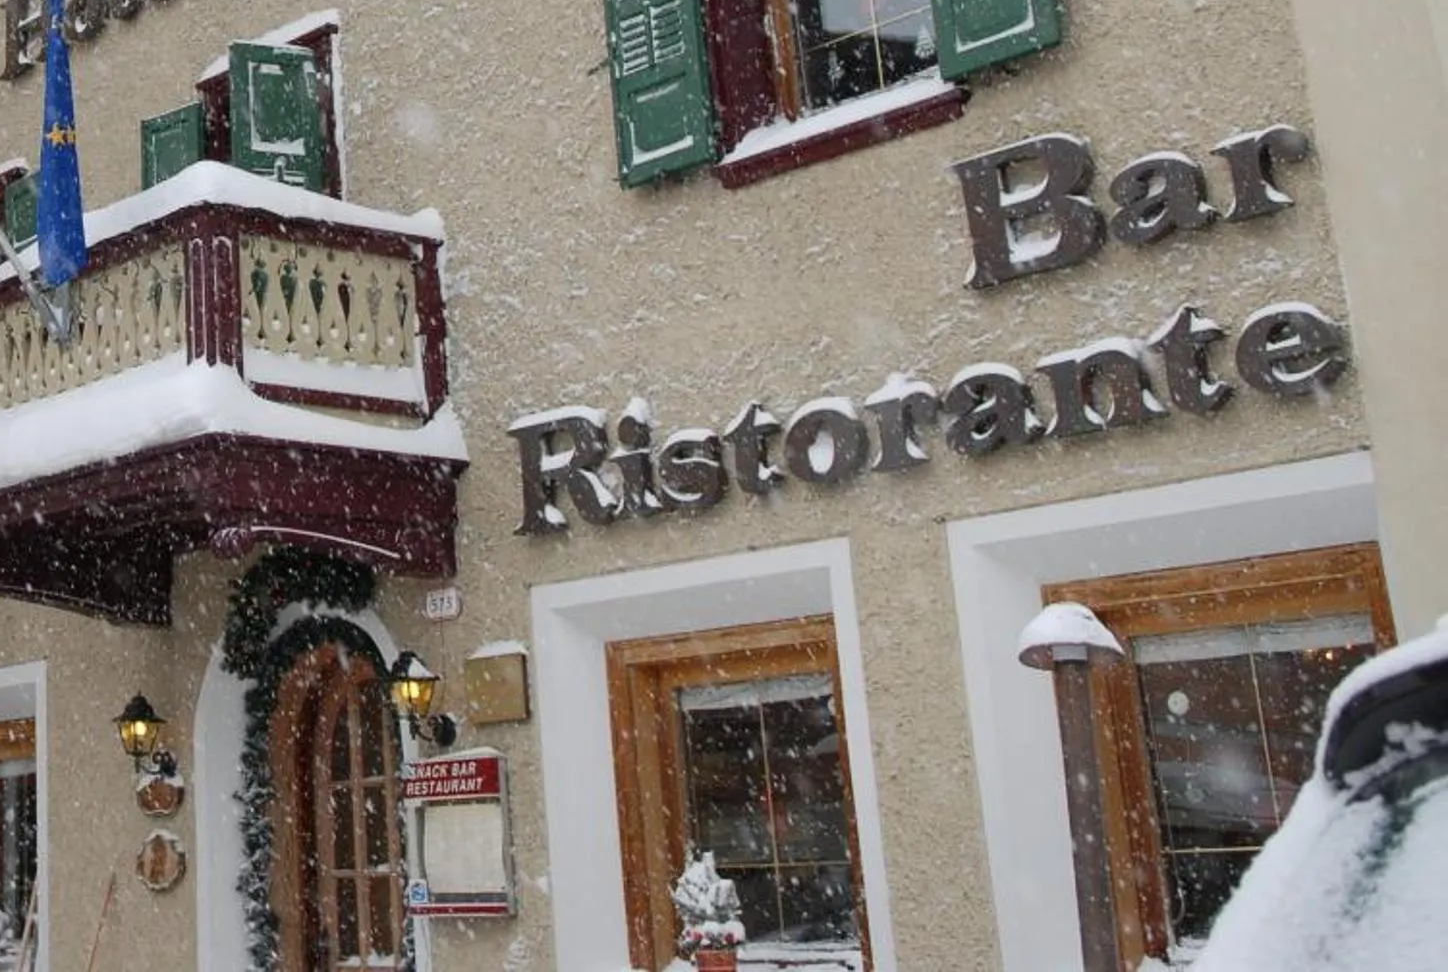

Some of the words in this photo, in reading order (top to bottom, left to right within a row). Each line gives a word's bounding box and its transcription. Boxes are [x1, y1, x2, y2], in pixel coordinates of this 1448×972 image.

[951, 124, 1310, 290] Bar
[509, 302, 1352, 536] Ristorante
[406, 777, 484, 796] RESTAURANT
[451, 760, 477, 777] BAR
